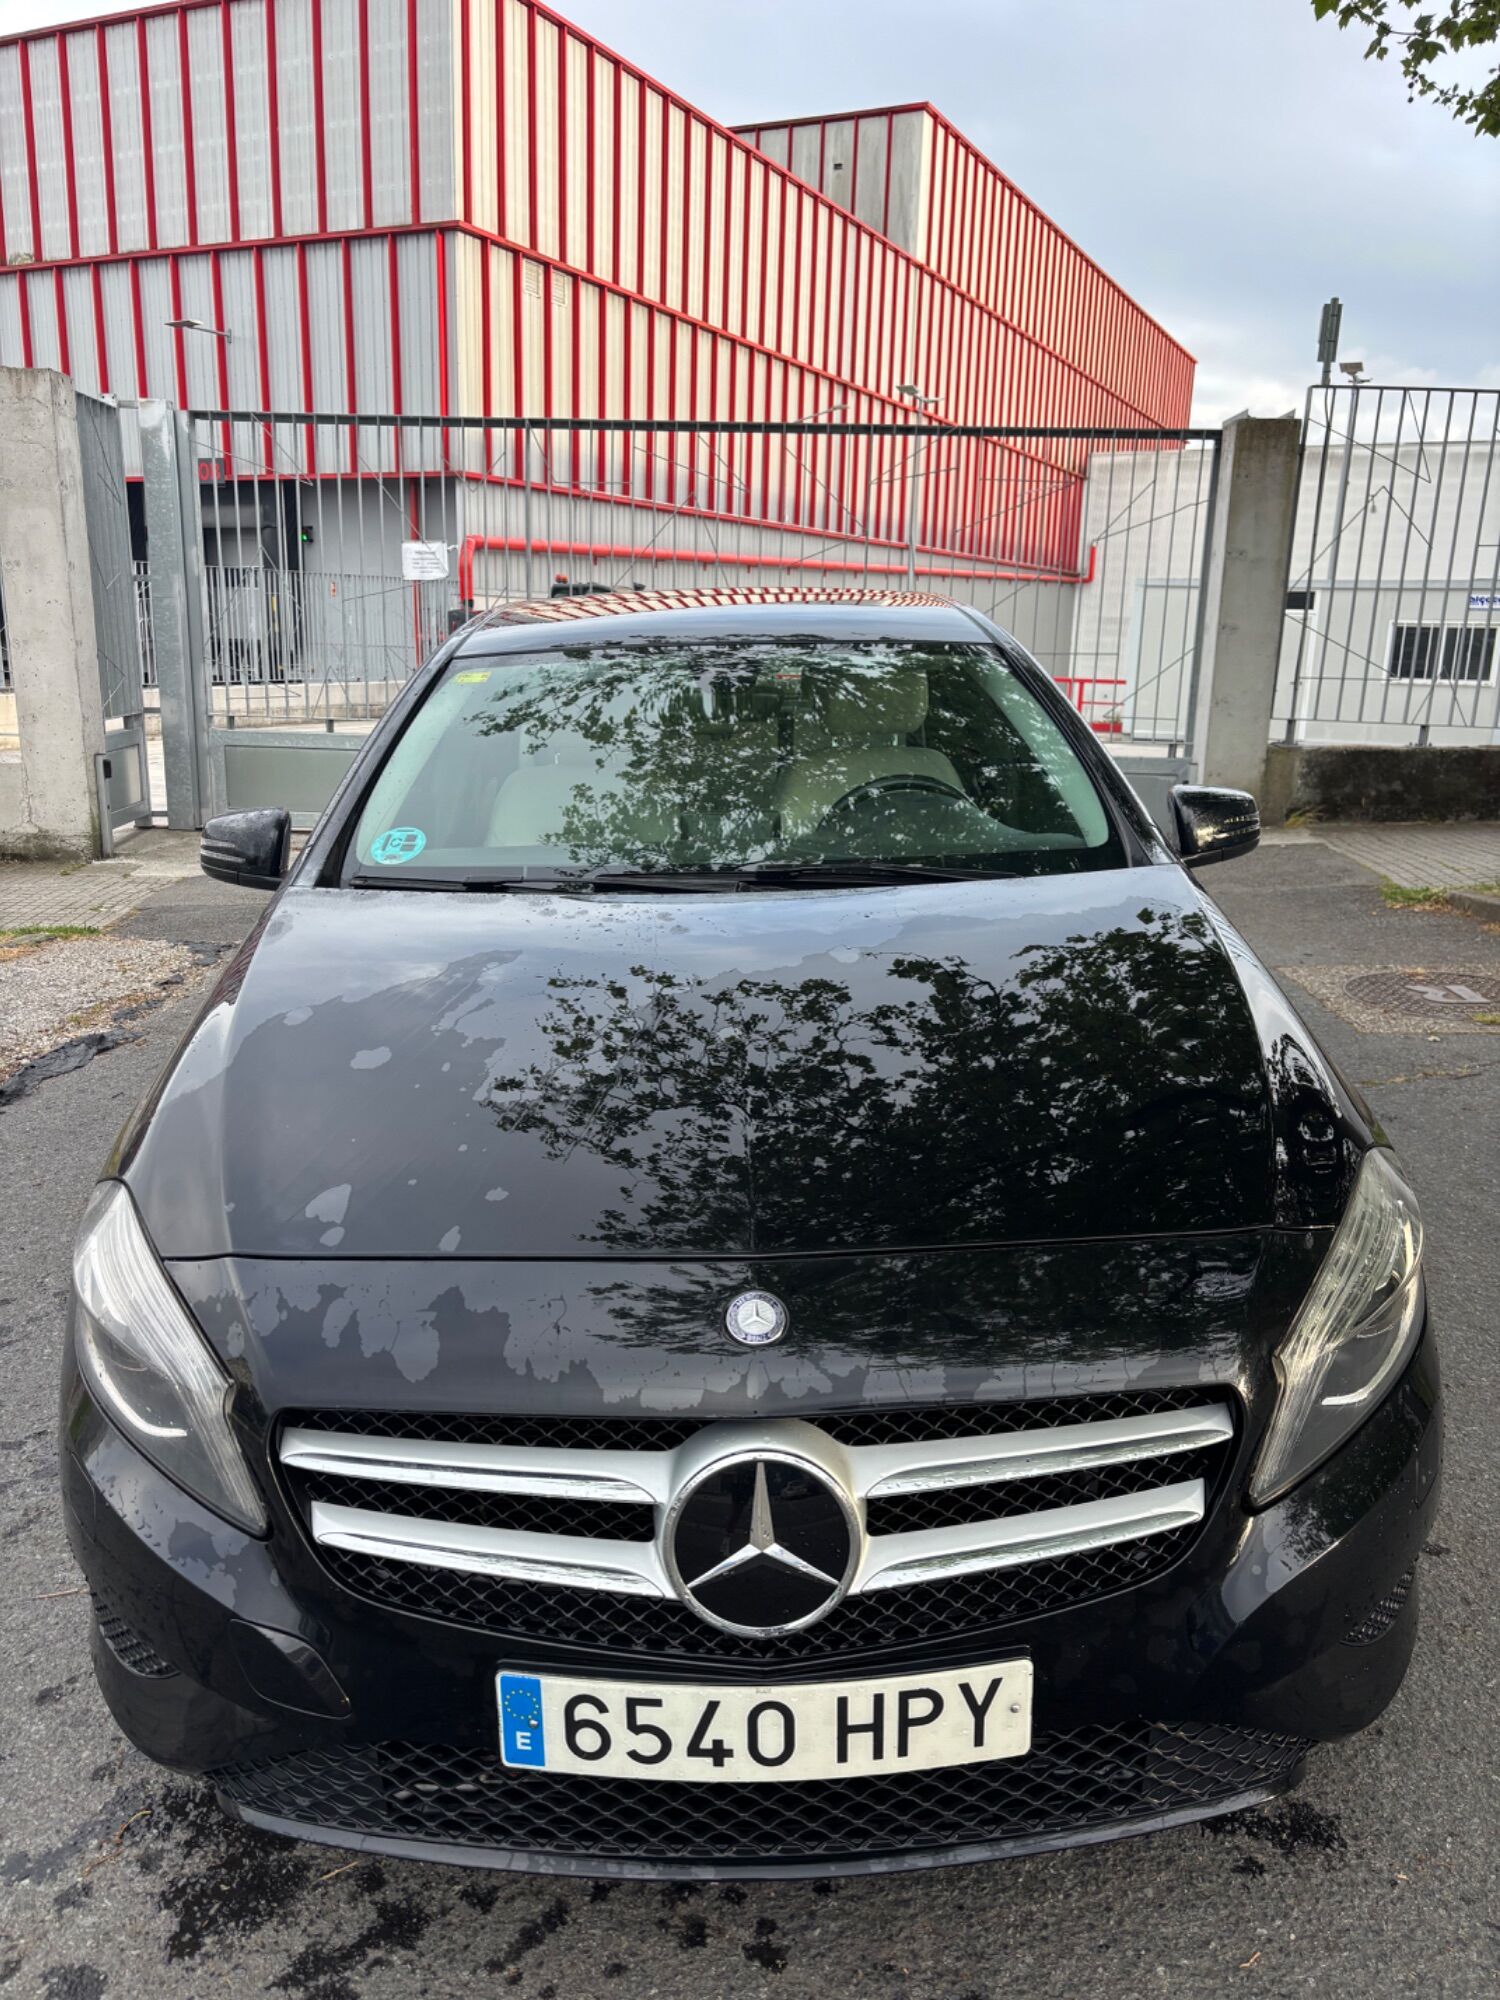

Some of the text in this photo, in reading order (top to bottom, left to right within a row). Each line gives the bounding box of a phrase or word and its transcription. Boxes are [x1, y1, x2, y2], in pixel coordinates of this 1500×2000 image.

[515, 1731, 532, 1750] E
[564, 1677, 1003, 1767] 6540 HPY
